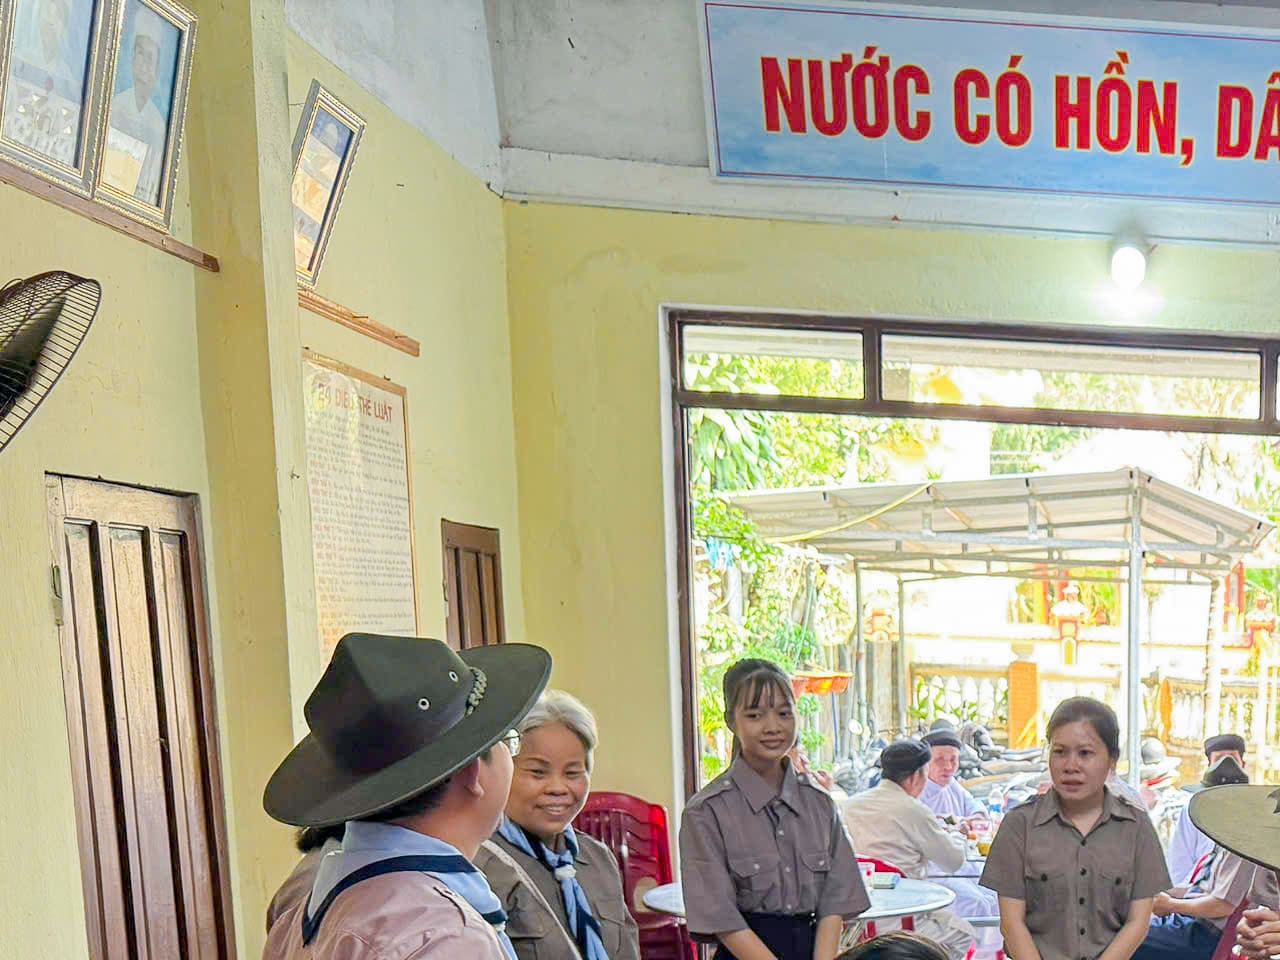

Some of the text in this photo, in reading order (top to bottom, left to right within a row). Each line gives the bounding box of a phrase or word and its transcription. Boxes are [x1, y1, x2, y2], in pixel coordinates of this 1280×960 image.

[761, 46, 932, 142] NƯỚC
[953, 55, 1033, 148] CÓ
[1055, 52, 1195, 167] HỒN,
